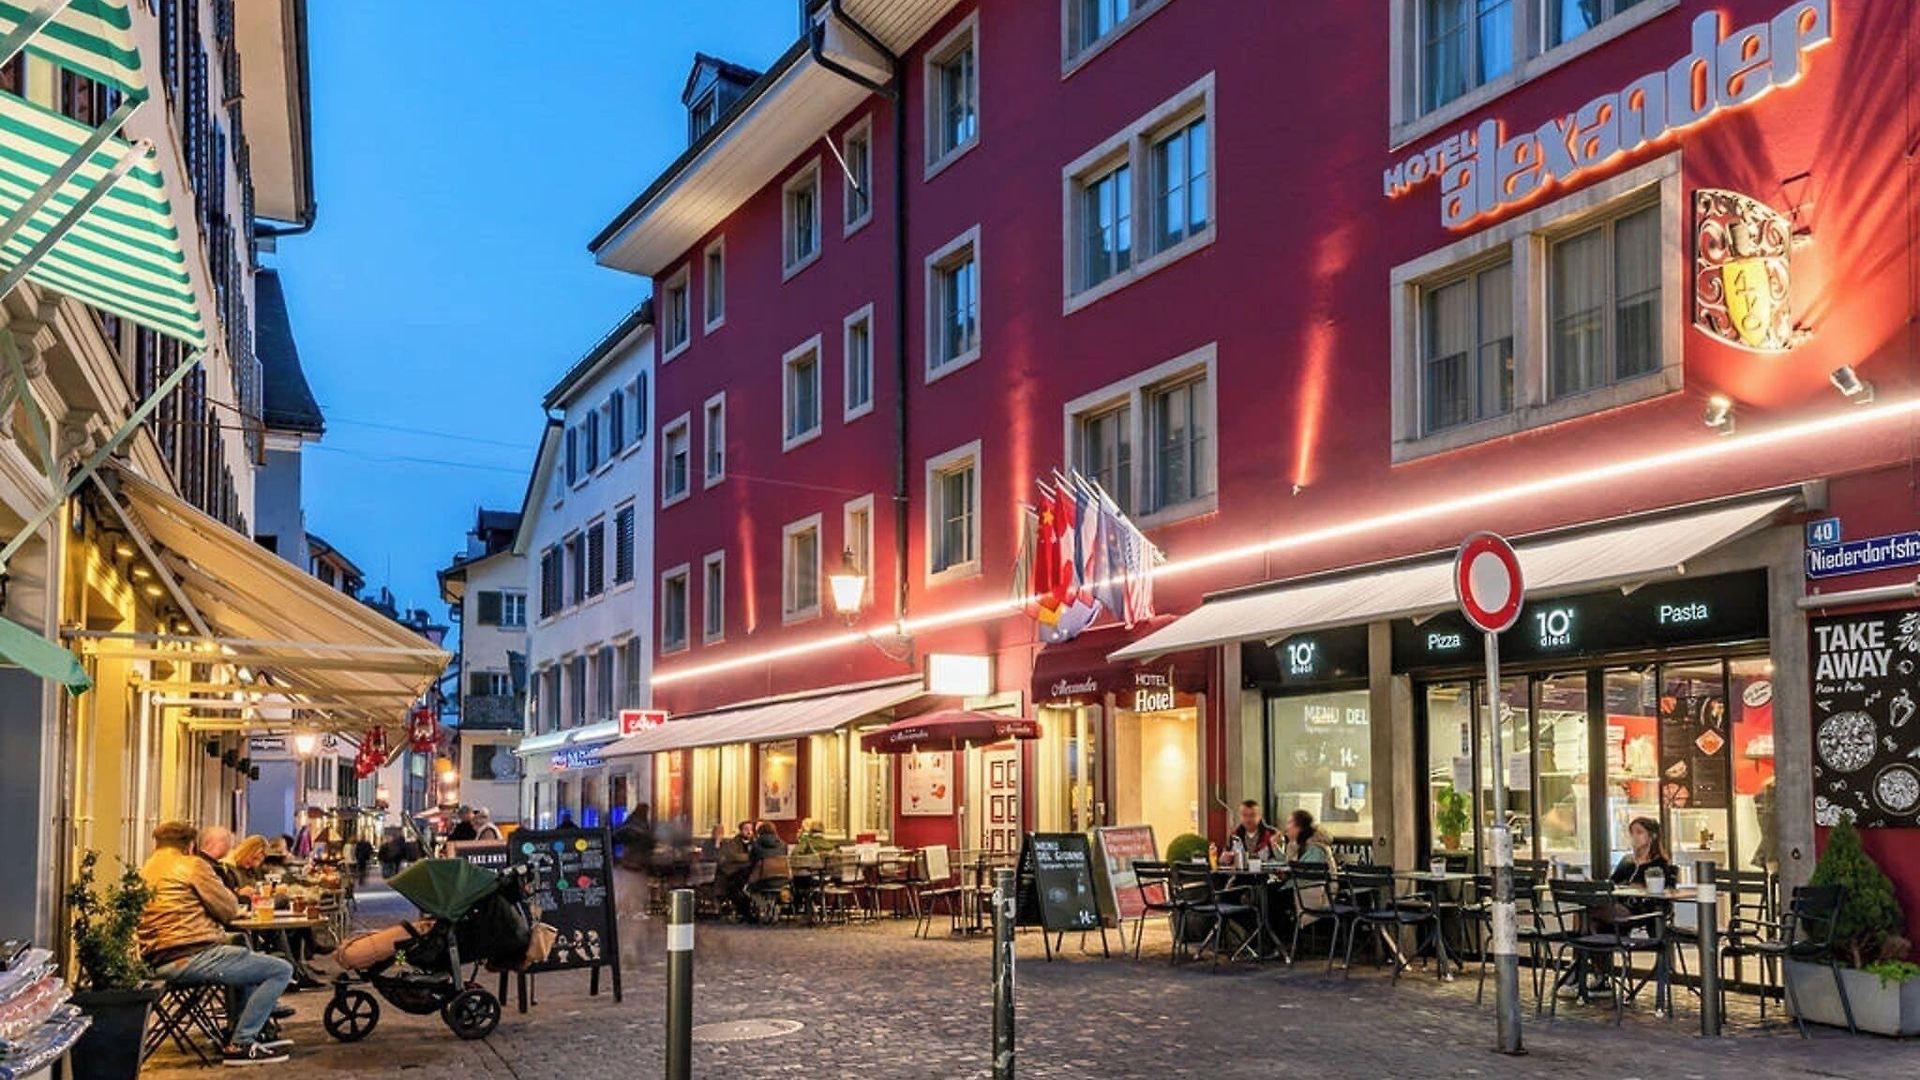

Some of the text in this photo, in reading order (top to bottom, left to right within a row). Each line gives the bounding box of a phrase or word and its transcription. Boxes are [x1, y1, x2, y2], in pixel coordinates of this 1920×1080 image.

[1383, 130, 1478, 197] HOTEL
[1813, 523, 1833, 542] 40
[1659, 601, 1708, 624] Pasta
[1428, 633, 1461, 650] Pizza
[1540, 633, 1570, 647] dieci
[1814, 620, 1886, 652] TAKE
[1815, 649, 1893, 680] AWAY
[1135, 673, 1168, 686] HOTEL
[1135, 685, 1175, 712] Hotel
[1345, 707, 1370, 725] DEL
